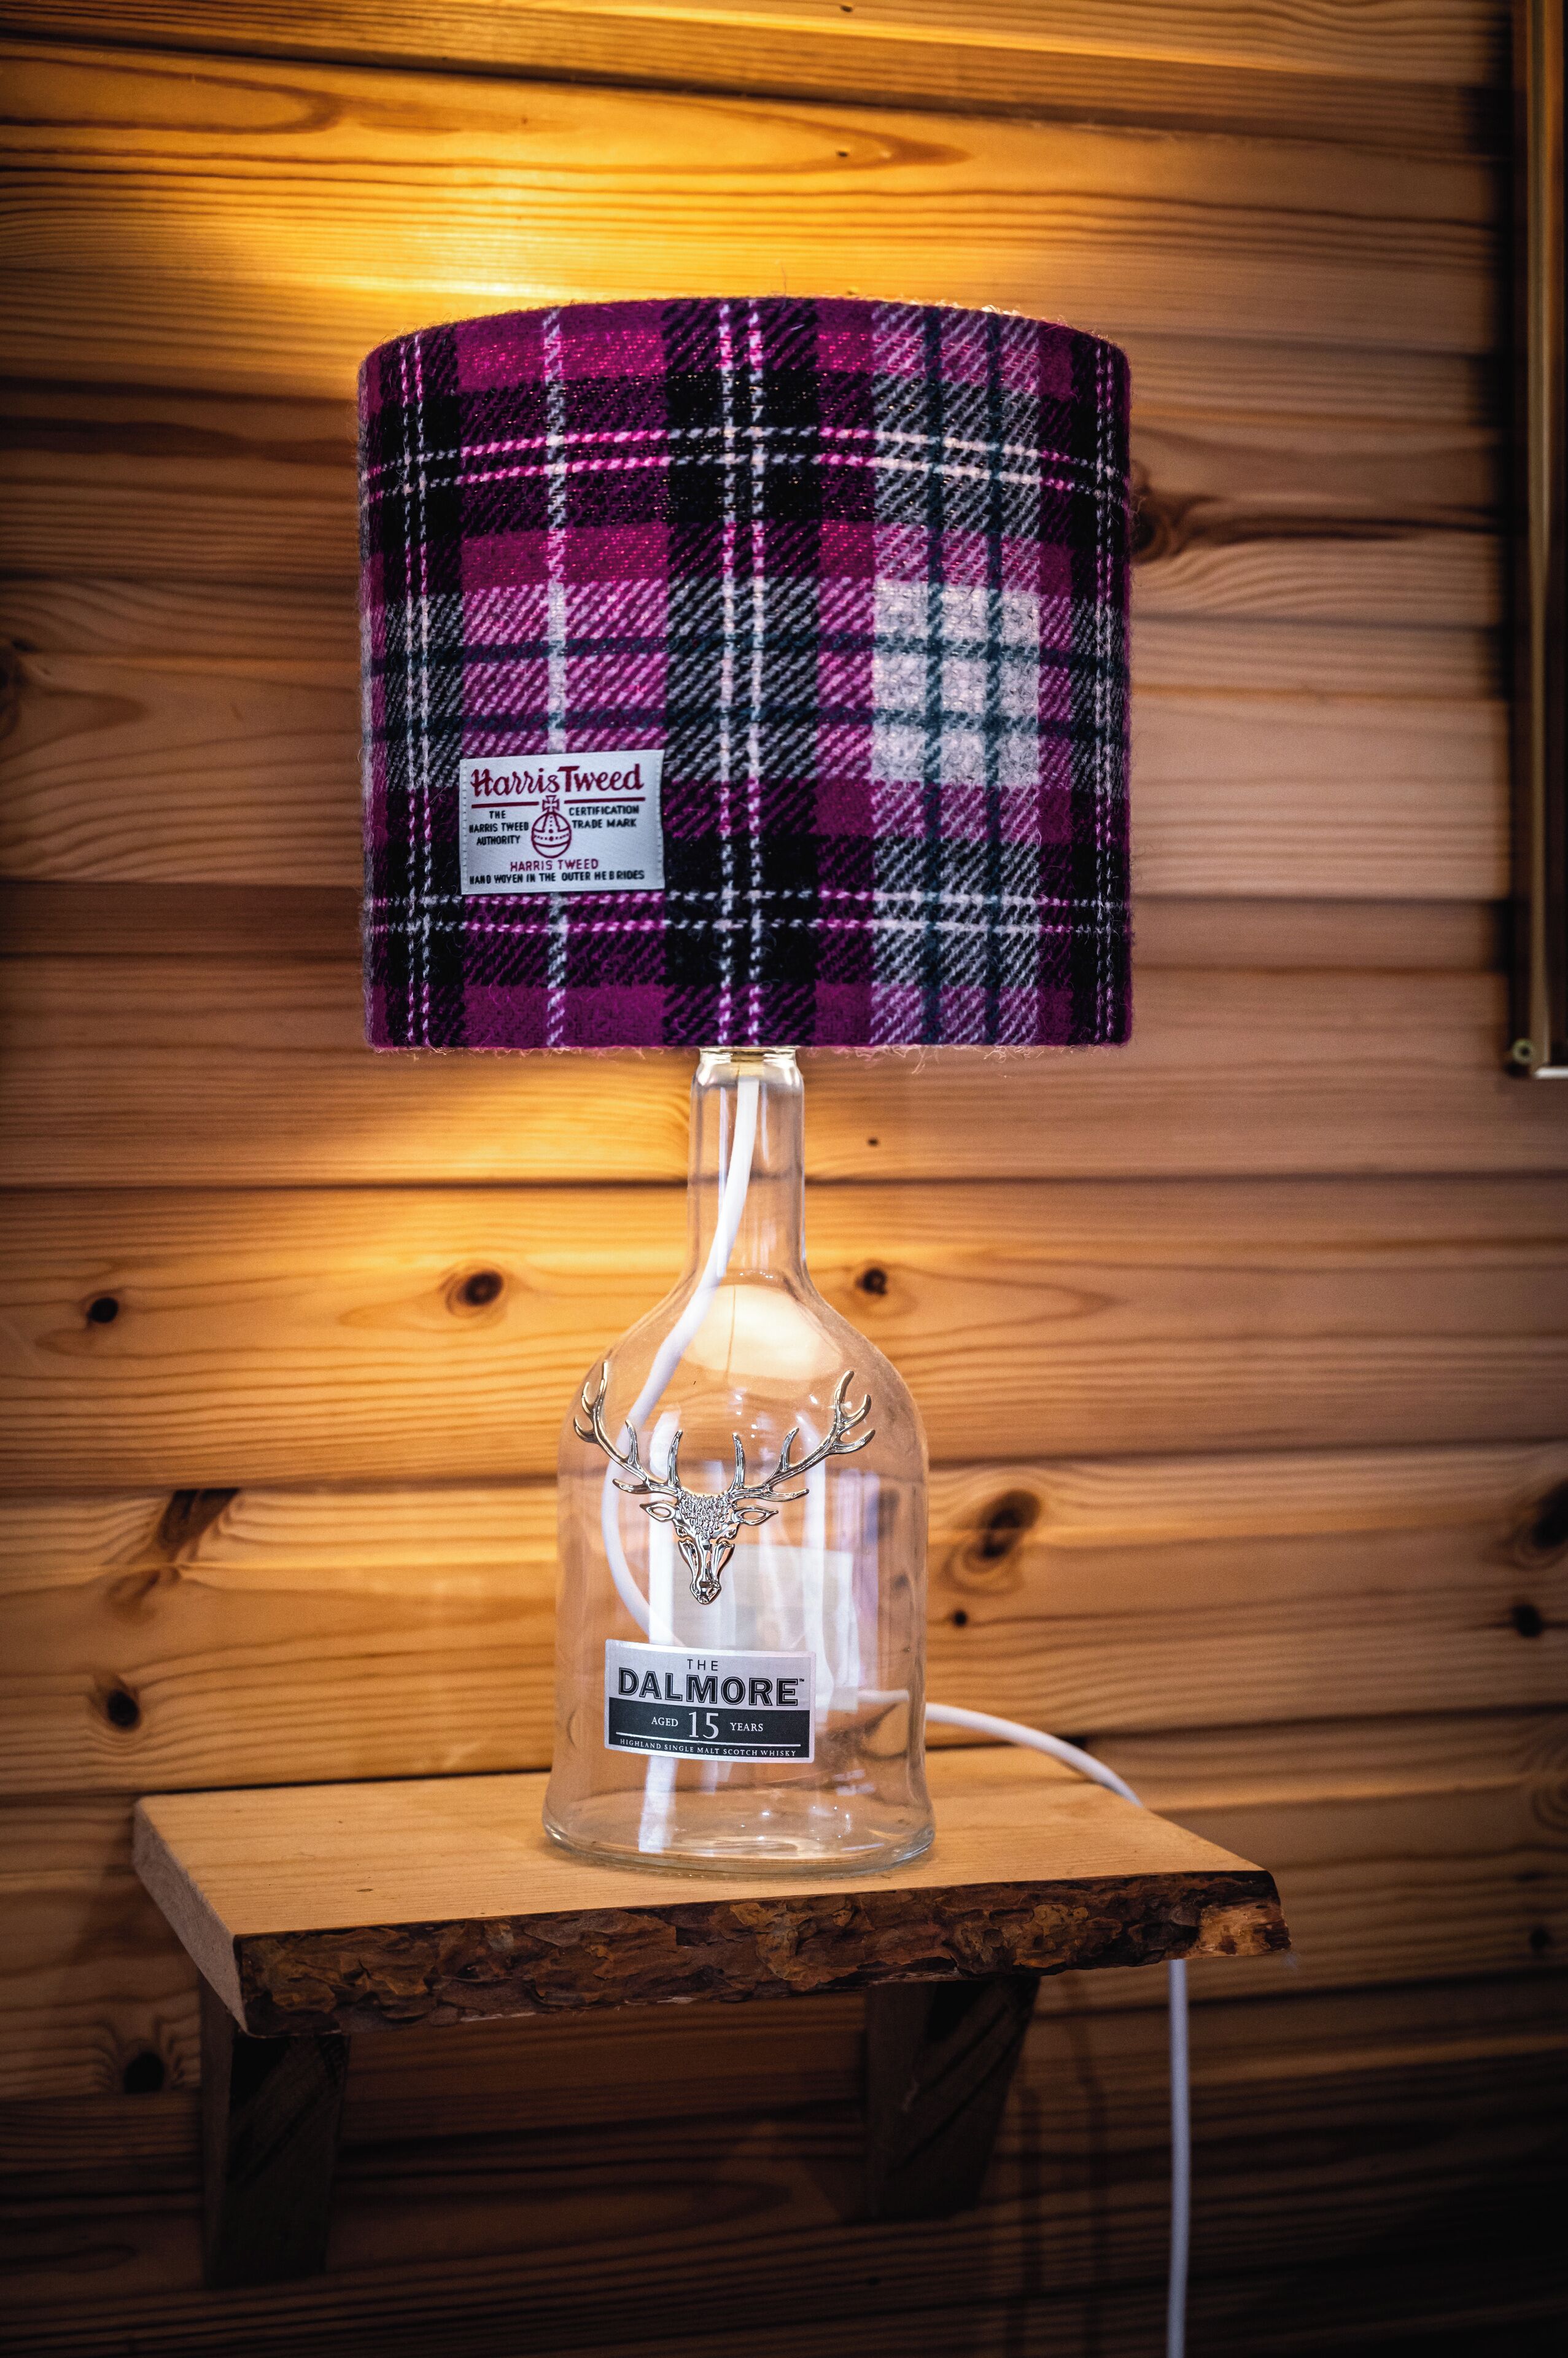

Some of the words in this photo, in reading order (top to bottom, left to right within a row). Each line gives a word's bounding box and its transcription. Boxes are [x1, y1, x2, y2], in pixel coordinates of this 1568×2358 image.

[471, 768, 560, 796] Harris
[557, 763, 644, 792] Tweed
[489, 811, 506, 819] THE
[569, 806, 639, 815] CERTIFICATION
[469, 823, 498, 833] HARRIS
[502, 822, 529, 831] TWEED
[572, 819, 602, 828] TRADE
[607, 818, 636, 827] MARK
[476, 835, 521, 845] AUTHORITY
[510, 860, 553, 871] HARRIS
[557, 859, 599, 870] TWEED
[470, 876, 491, 884] HAND
[494, 874, 523, 883] WOVEN
[526, 873, 535, 882] IN
[538, 873, 556, 882] THE
[562, 871, 591, 881] OUTER
[687, 1659, 718, 1671] THE
[651, 1716, 678, 1727] AGED
[688, 1711, 719, 1739] 15
[730, 1722, 763, 1732] YEARS
[620, 1739, 661, 1749] HIGHLAND
[664, 1744, 694, 1753] SINGLE
